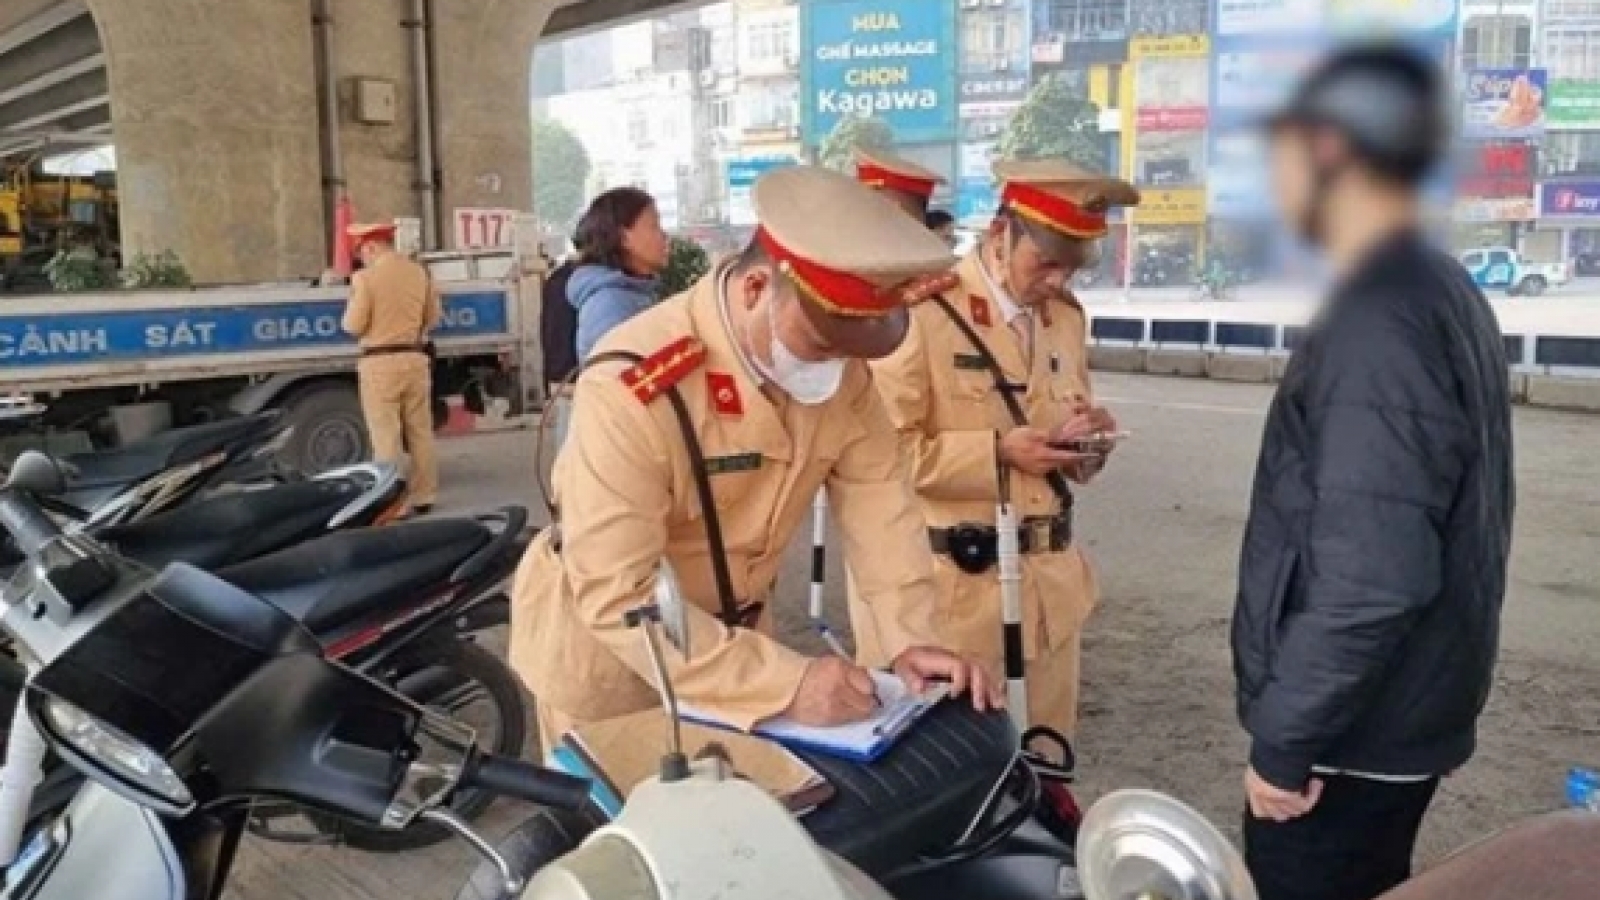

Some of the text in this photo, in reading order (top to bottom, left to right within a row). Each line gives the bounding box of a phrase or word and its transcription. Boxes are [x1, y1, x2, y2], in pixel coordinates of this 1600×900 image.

[853, 12, 901, 32] MUA
[855, 39, 938, 57] MASSAGE
[818, 88, 938, 118] Kagawa
[0, 314, 337, 358] CẢNH SÁT GIAO
